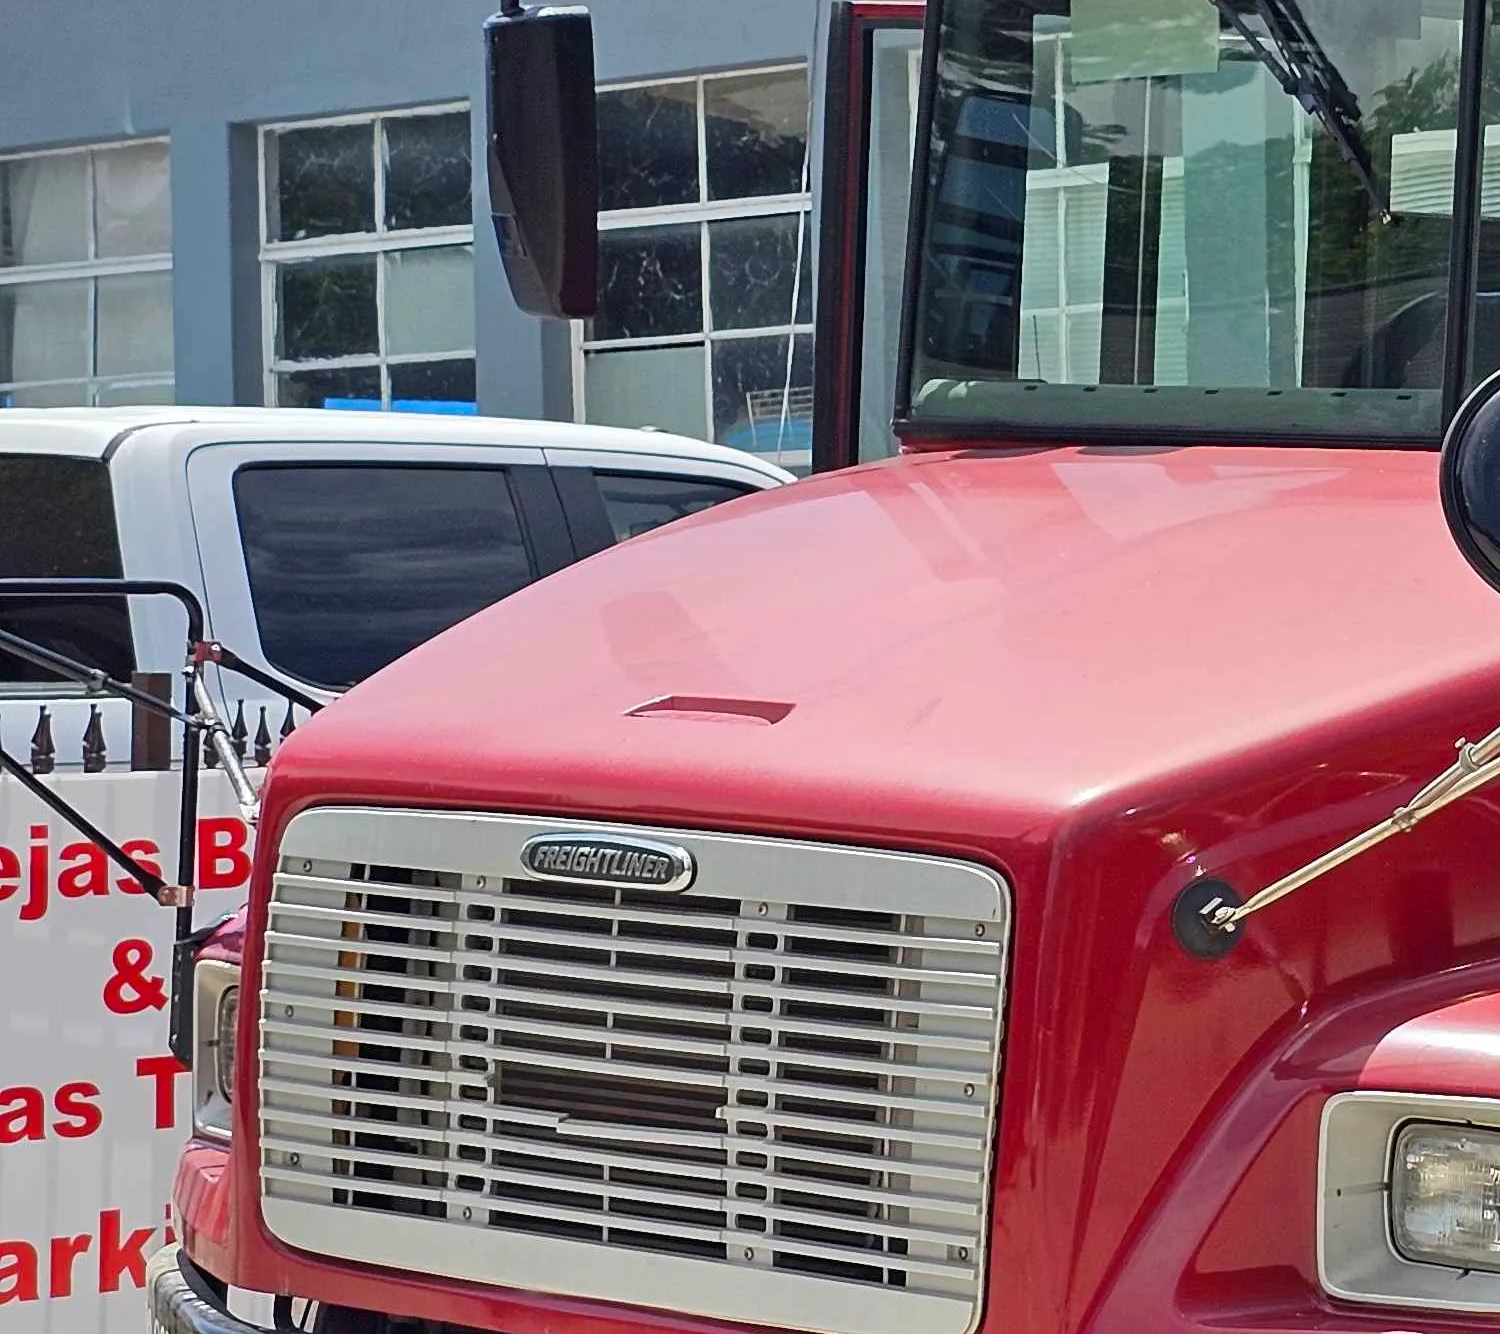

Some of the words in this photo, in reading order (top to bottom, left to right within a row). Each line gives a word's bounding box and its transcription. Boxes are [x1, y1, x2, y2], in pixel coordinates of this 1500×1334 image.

[534, 845, 670, 880] FREIGHTLINER
[102, 938, 169, 1015] &
[0, 1204, 176, 1304] ark
